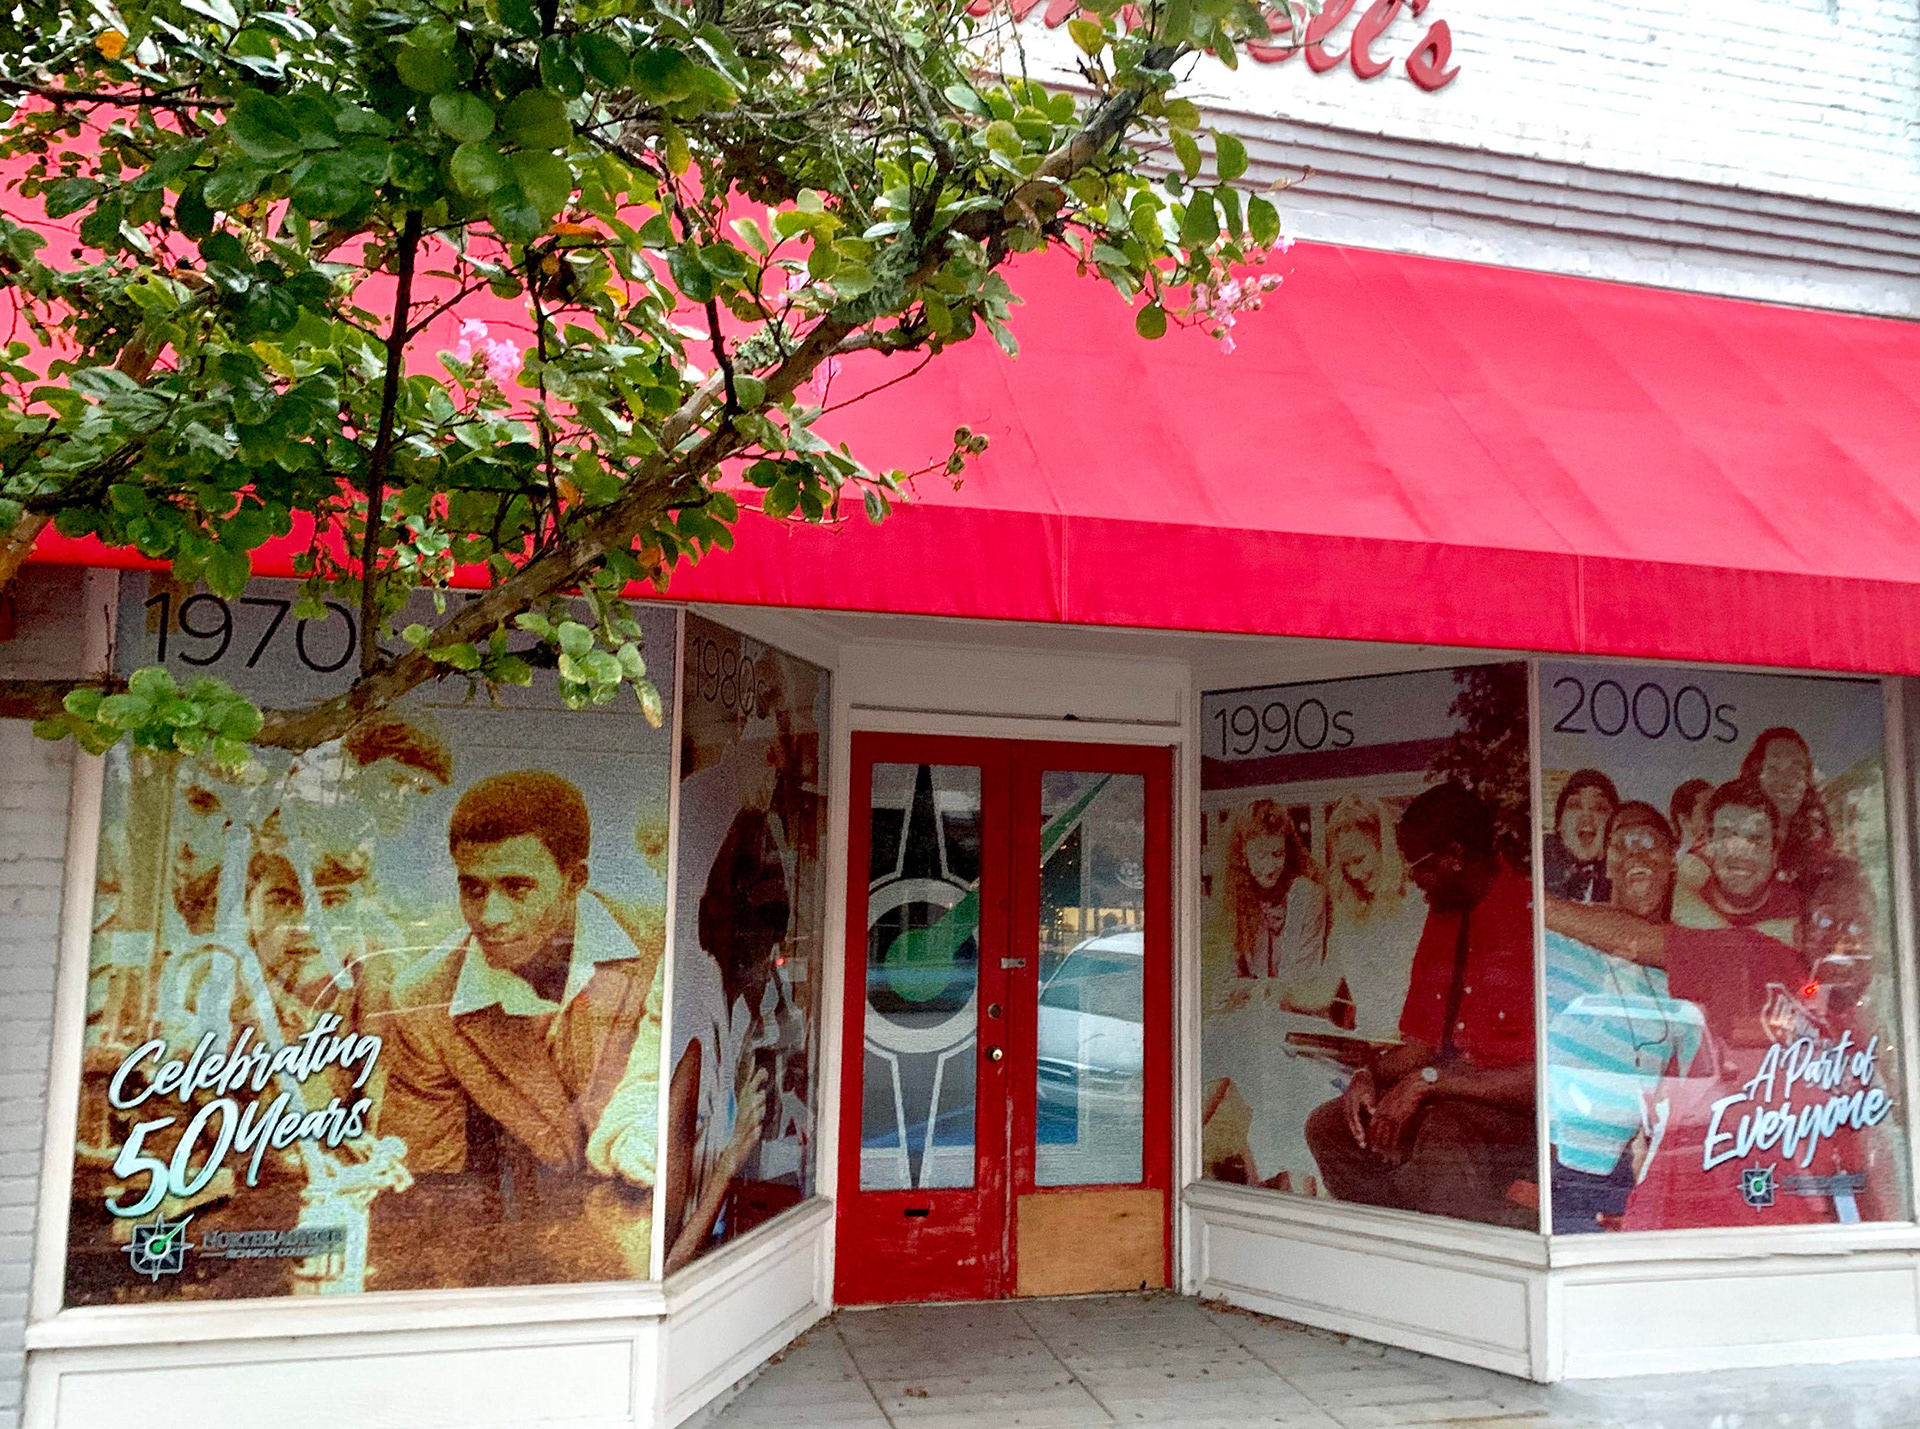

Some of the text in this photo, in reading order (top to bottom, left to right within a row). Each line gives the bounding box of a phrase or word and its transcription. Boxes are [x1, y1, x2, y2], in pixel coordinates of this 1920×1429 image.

[144, 592, 398, 673] 1970
[692, 635, 768, 720] 1980s
[1553, 676, 1740, 745] 2000s
[1213, 698, 1355, 756] 1990s
[108, 1012, 383, 1110] Celebrating
[1742, 1029, 1879, 1103] A Part of
[104, 1091, 373, 1217] 50 Years
[1702, 1087, 1894, 1171] Everyone
